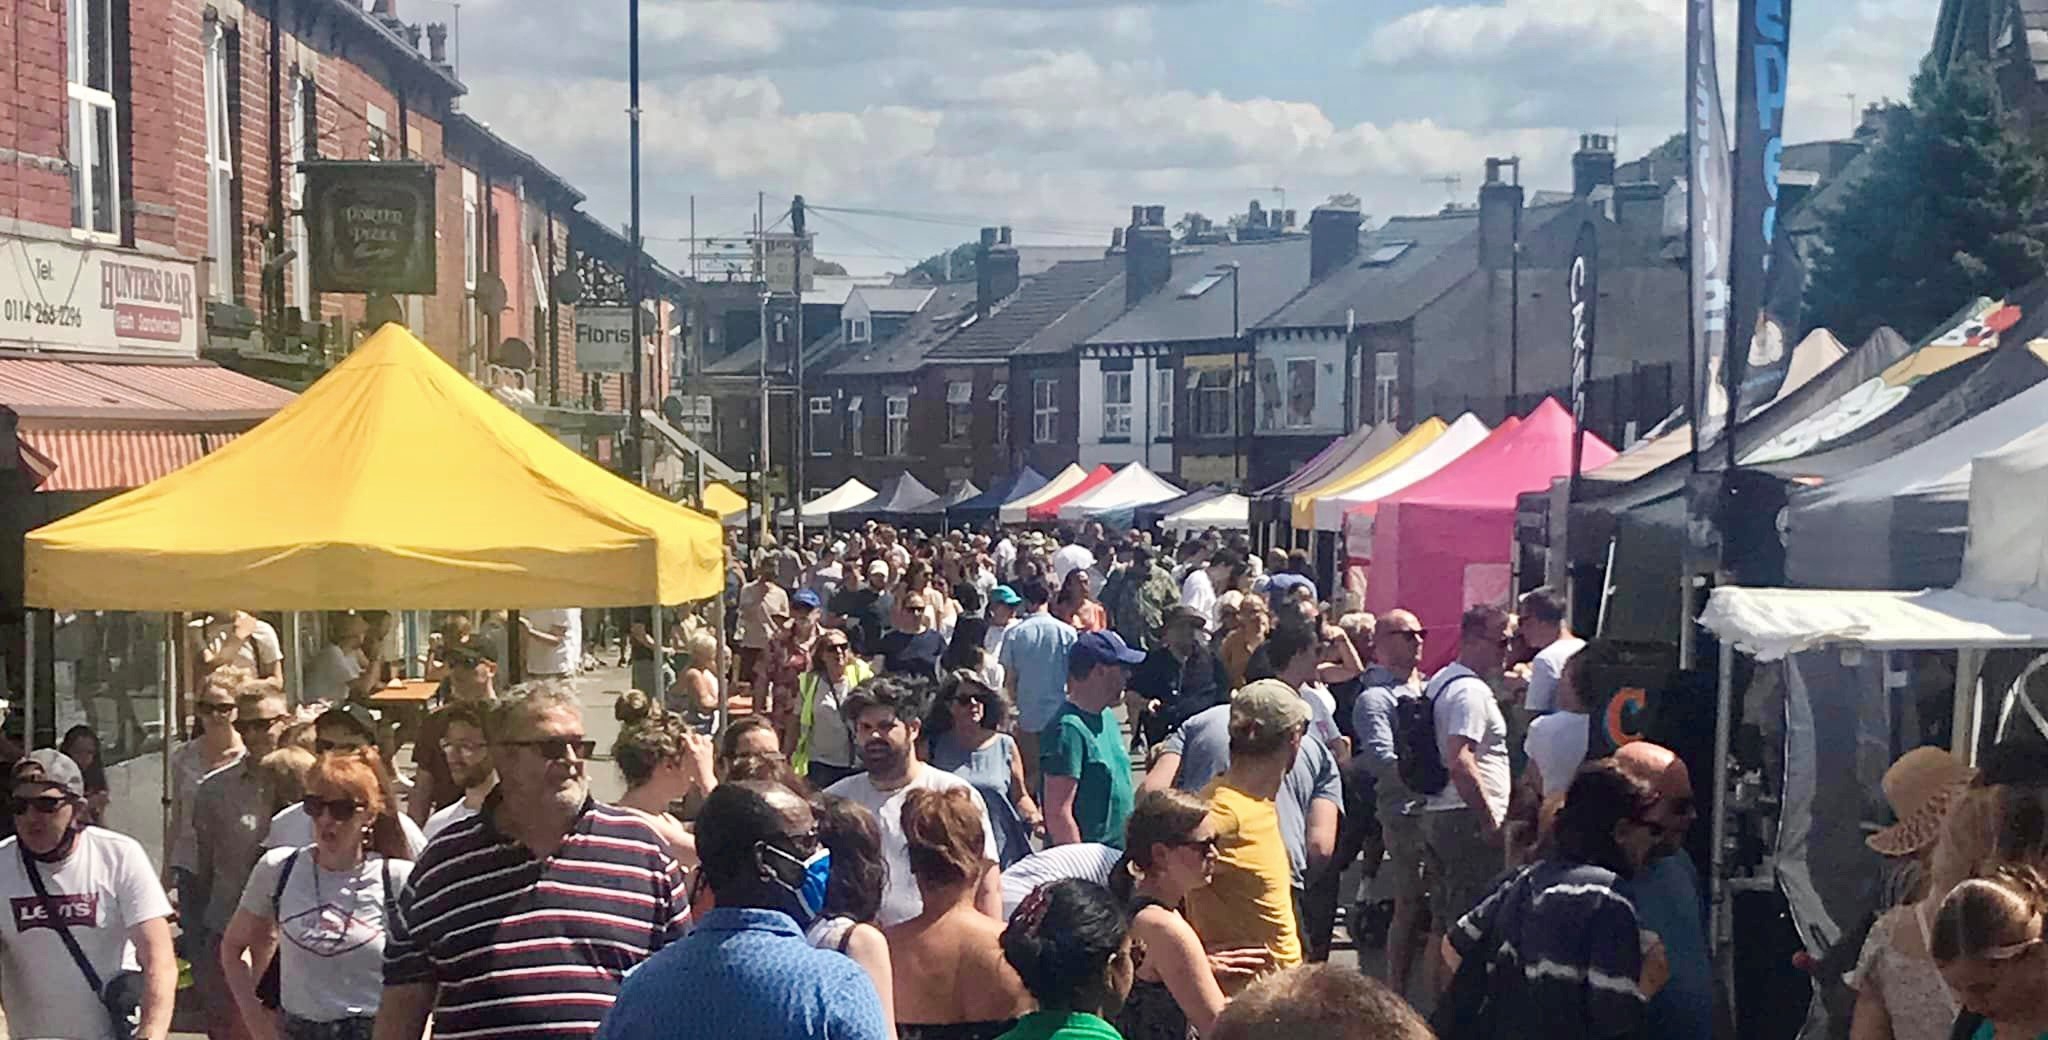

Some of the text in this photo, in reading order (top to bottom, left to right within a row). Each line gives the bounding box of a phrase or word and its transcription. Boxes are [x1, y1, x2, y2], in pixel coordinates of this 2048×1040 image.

[164, 270, 194, 319] BAR
[4, 299, 31, 322] 0114
[576, 323, 631, 344] Floris
